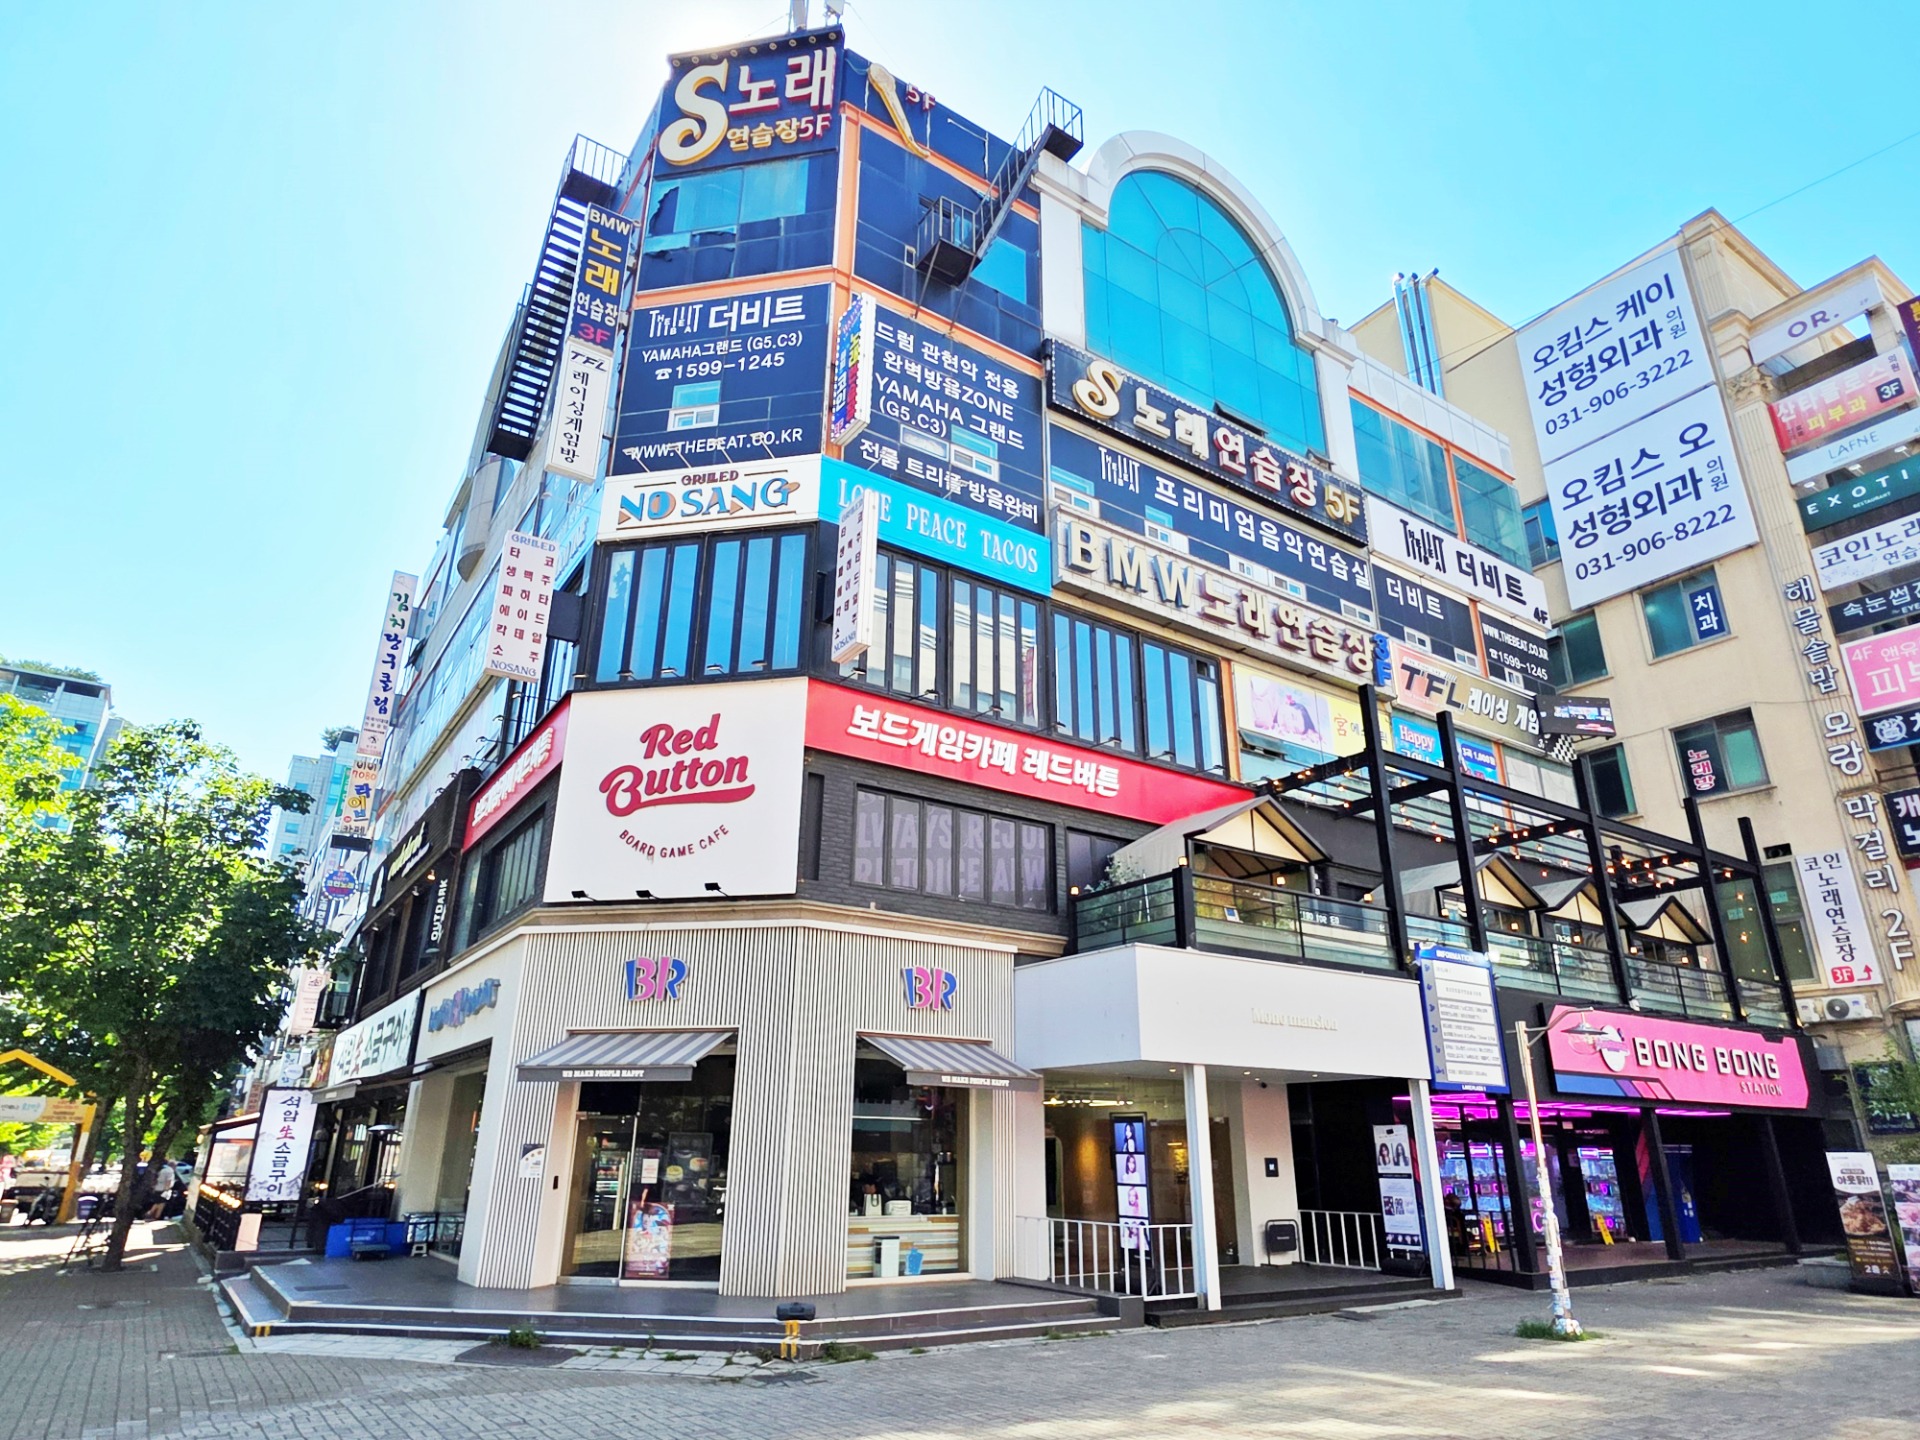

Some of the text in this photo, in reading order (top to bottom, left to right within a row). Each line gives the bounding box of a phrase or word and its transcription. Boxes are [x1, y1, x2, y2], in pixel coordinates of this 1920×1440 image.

[728, 46, 836, 115] 노래
[589, 209, 630, 235] BMW
[585, 228, 622, 297] 노래
[577, 291, 618, 328] 연습장
[578, 323, 611, 344] 3F
[708, 295, 806, 332] 더비트
[1533, 273, 1675, 374] 오킴스 케이
[570, 350, 607, 372] TFL
[676, 352, 785, 380] 1599-1245
[875, 321, 1020, 400] 드럼 관현악 전용
[1538, 305, 1688, 407] 성형외과 의원
[875, 373, 964, 426] YAMAHA
[969, 414, 1025, 450] 그랜드
[1545, 348, 1694, 436] 031-906-3222
[1807, 381, 1902, 431] 피부과 3F
[1132, 386, 1318, 508] 노래연습장
[1324, 483, 1361, 527] 5F
[1562, 422, 1716, 513] 오킴스 오
[617, 477, 801, 526] NOSANG
[1567, 455, 1729, 550] 성형외과 의원
[905, 502, 968, 550] PEACE
[981, 529, 1038, 575] TACOS
[1154, 475, 1371, 592] 프리미엄음악연습실
[1575, 503, 1737, 582] 031-906-8222
[1068, 521, 1394, 688] BMW 노래연습장 3F
[1386, 577, 1445, 620] 더비트
[1456, 550, 1528, 606] 더비트
[1533, 606, 1549, 625] 4F
[1693, 592, 1719, 631] 치과
[1785, 575, 1838, 694] 해물솥밥
[1852, 645, 1873, 661] 4F
[491, 659, 537, 677] NOSANG
[1498, 650, 1549, 682] 1599-1245
[1401, 664, 1466, 710] TFL
[1467, 686, 1510, 725] 레이싱
[640, 713, 721, 760] Red
[847, 704, 1121, 799] 보드게임카페 레드버튼
[1399, 725, 1435, 752] Happy
[352, 769, 377, 781] 7080
[599, 755, 756, 817] Button
[1687, 749, 1716, 791] 노래방
[619, 824, 730, 859] BOARD GAME CAFE
[1844, 793, 1899, 894] 막걸리
[1881, 908, 1915, 972] 2F
[430, 879, 449, 941] OUTDARK
[624, 954, 689, 1002] BR
[901, 964, 958, 1012] BR
[1832, 968, 1853, 983] 3F
[594, 1069, 621, 1078] PEOPLE
[621, 1069, 645, 1078] HAPPY
[1633, 1037, 1780, 1080] BONG BONG
[1740, 1080, 1783, 1096] STATION
